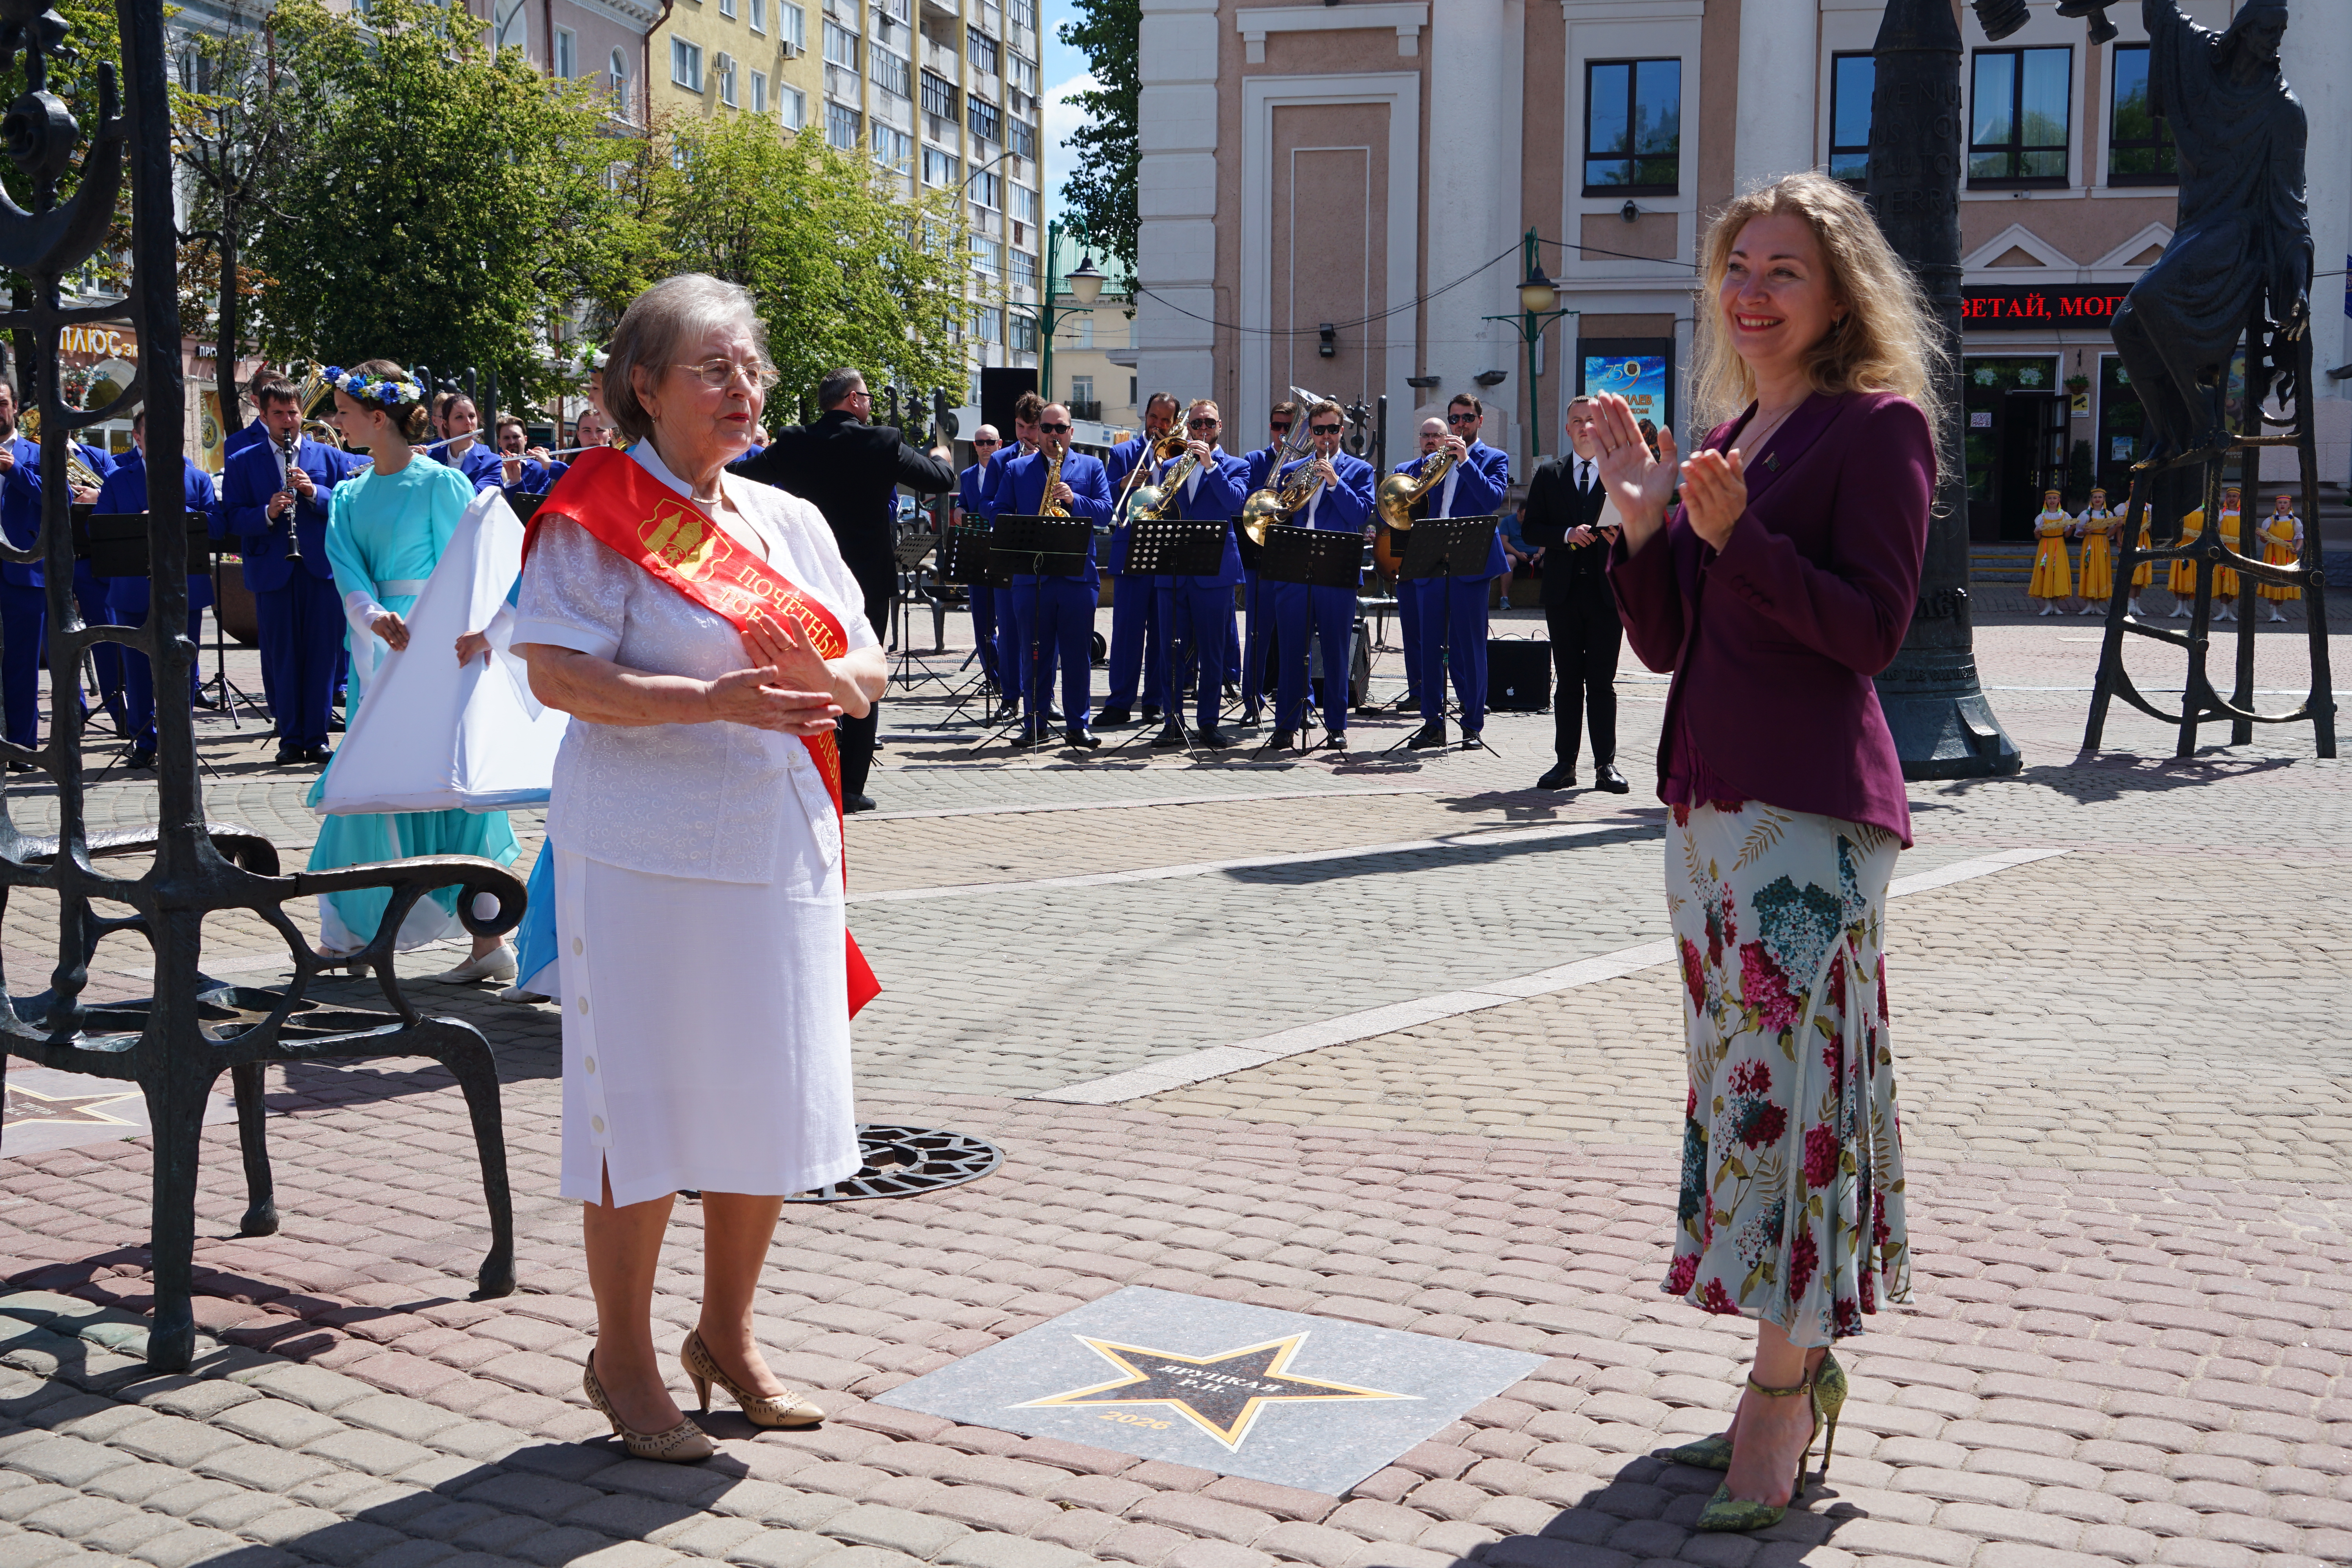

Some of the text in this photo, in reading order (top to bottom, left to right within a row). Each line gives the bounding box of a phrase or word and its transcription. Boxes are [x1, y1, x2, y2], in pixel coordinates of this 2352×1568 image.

[2059, 297, 2125, 316] МОГ
[60, 326, 122, 355] ПЛЮС
[717, 588, 765, 627] ГОР
[1156, 1365, 1283, 1392] ЯРУЦКАЯ
[1177, 1378, 1226, 1393] Р.И.
[1098, 1411, 1172, 1430] 2026
